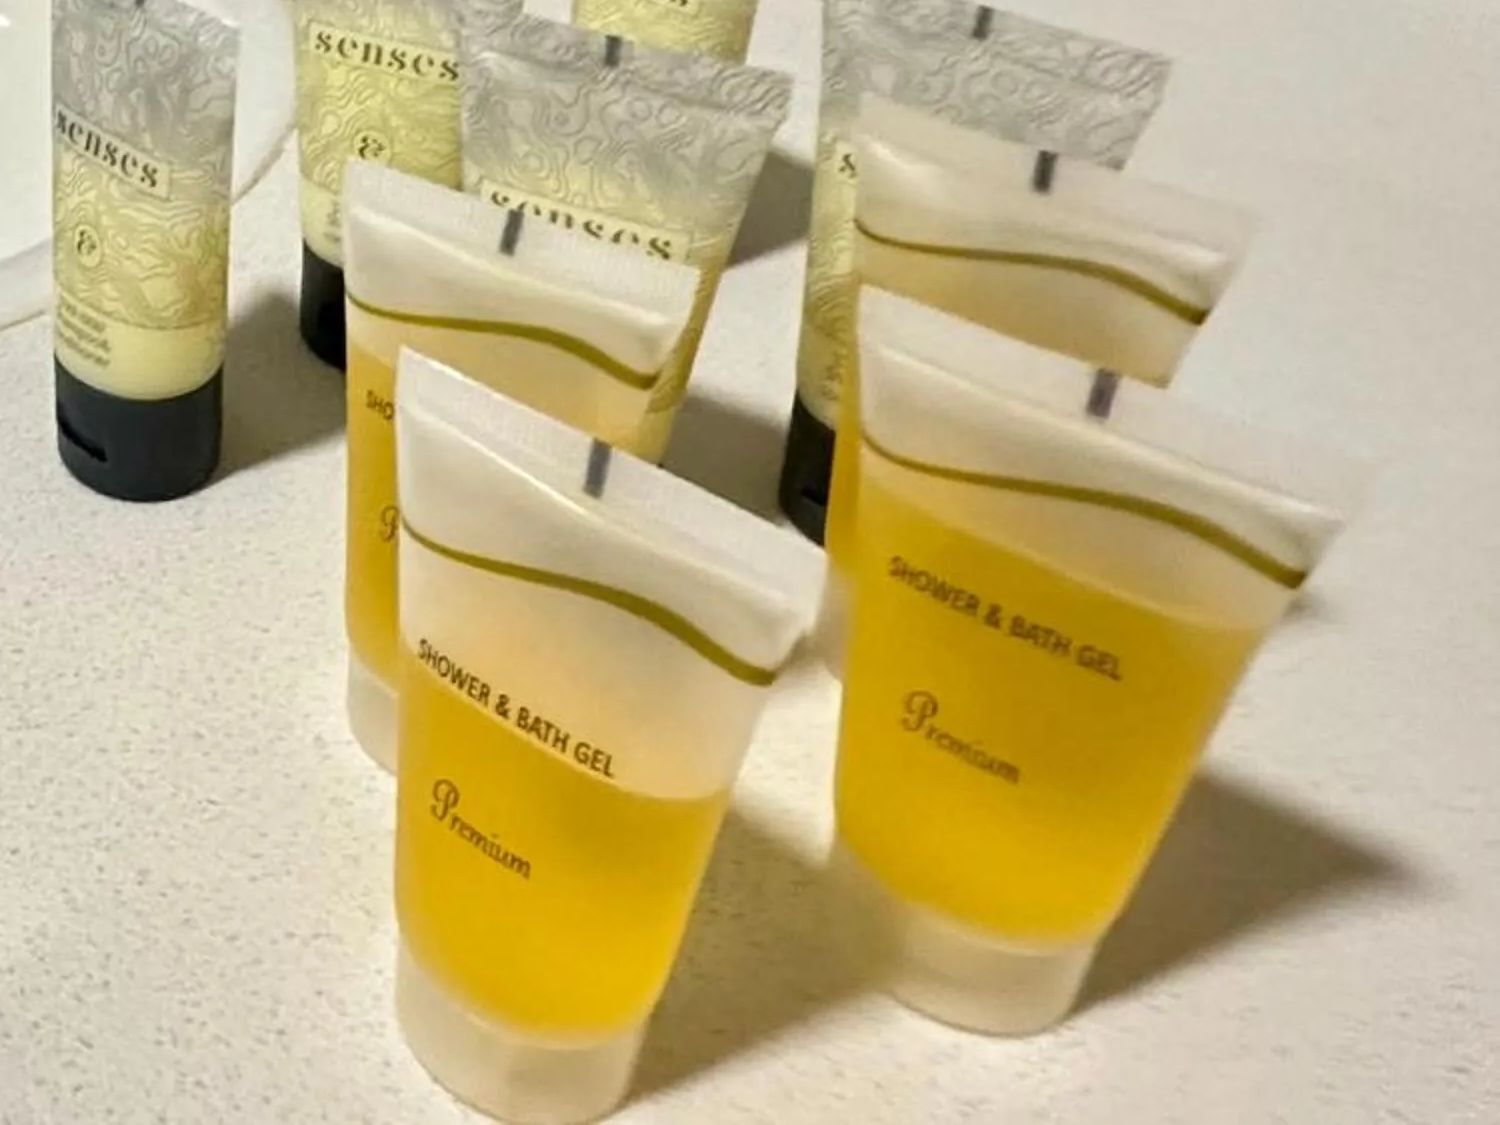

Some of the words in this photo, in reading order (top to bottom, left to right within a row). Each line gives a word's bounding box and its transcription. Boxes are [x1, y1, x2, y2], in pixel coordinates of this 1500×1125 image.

[315, 31, 459, 81] senses
[57, 110, 158, 188] senses
[888, 555, 980, 617] SHOWER
[984, 602, 1003, 631] &
[1009, 613, 1074, 659] BATH
[1076, 644, 1123, 681] GEL
[418, 638, 492, 706] SHOWER
[494, 694, 512, 720] &
[516, 706, 571, 753] BATH
[573, 742, 615, 778] GEL
[901, 690, 1020, 784] Premium
[430, 778, 532, 879] Premium
